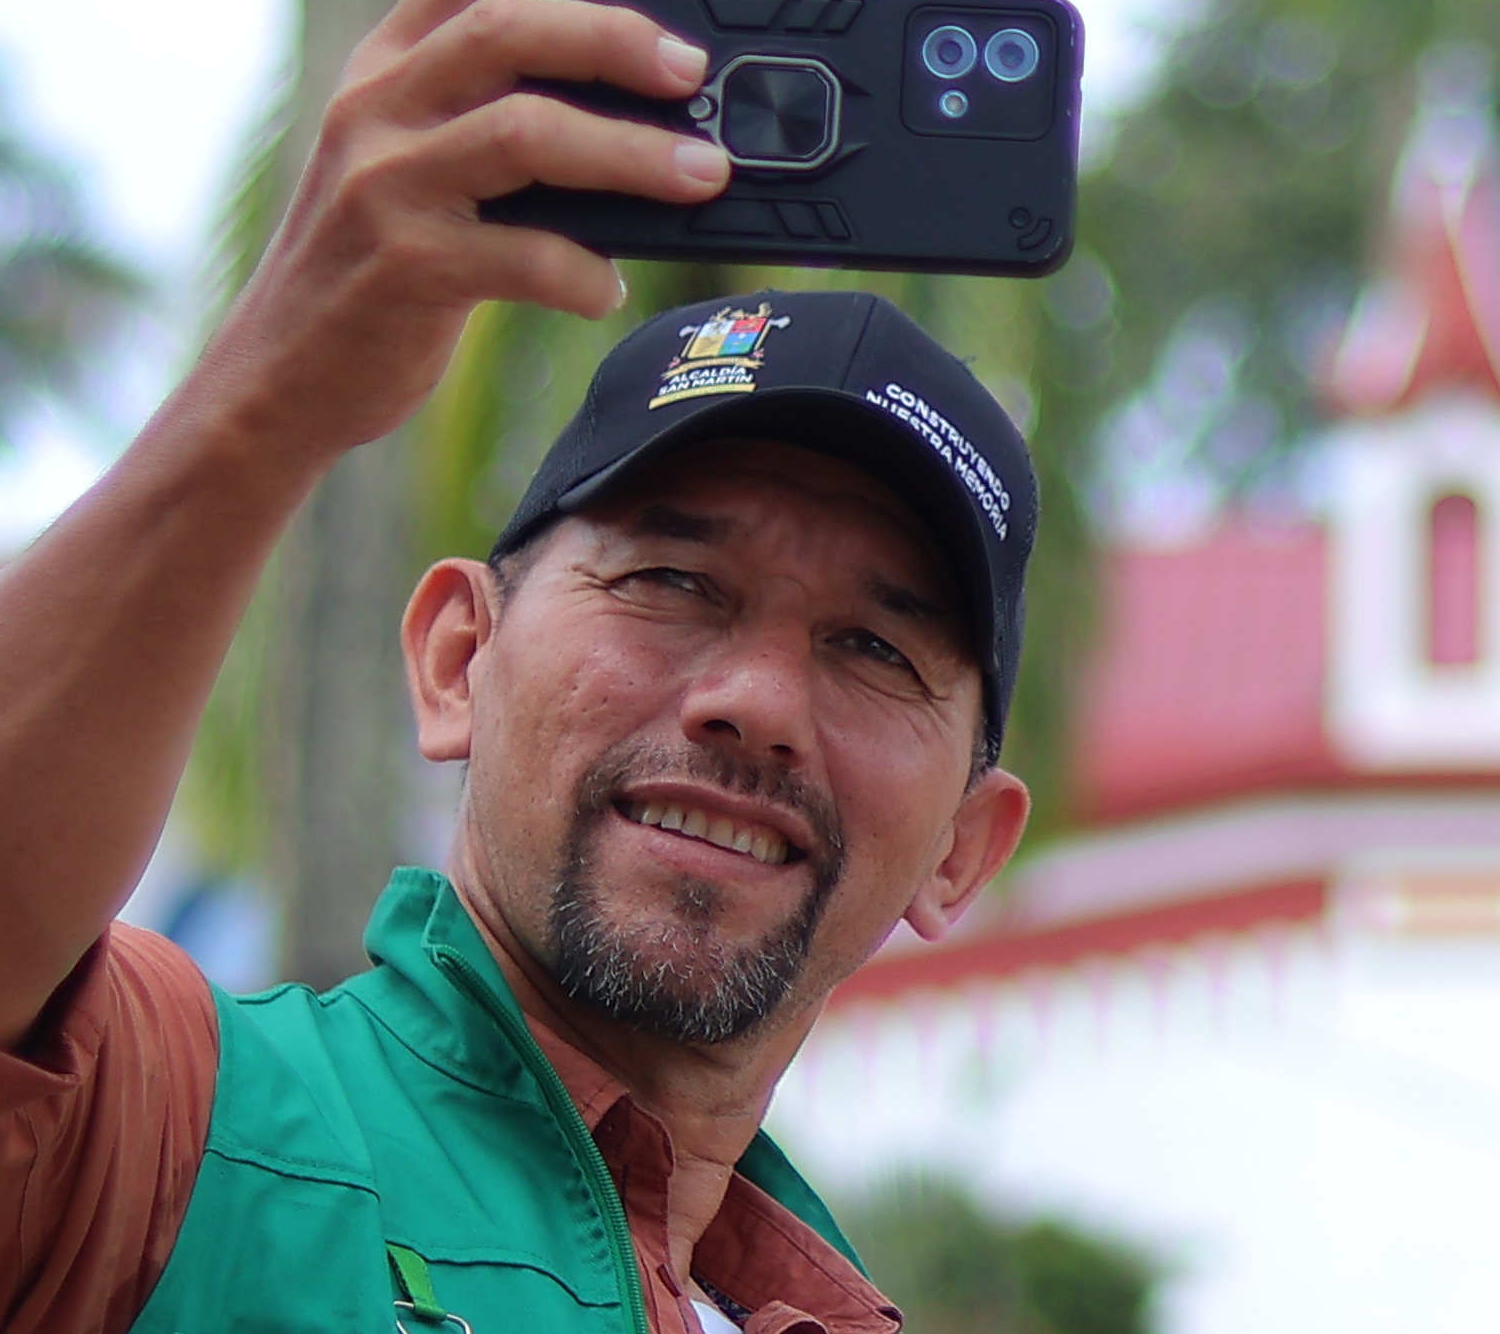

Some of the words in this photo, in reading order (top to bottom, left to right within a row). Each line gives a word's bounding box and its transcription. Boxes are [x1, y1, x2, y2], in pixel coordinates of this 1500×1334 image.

[658, 380, 690, 396] SAN
[885, 383, 1011, 512] CONSTRUYENDO
[954, 456, 1008, 542] MEMORIA
